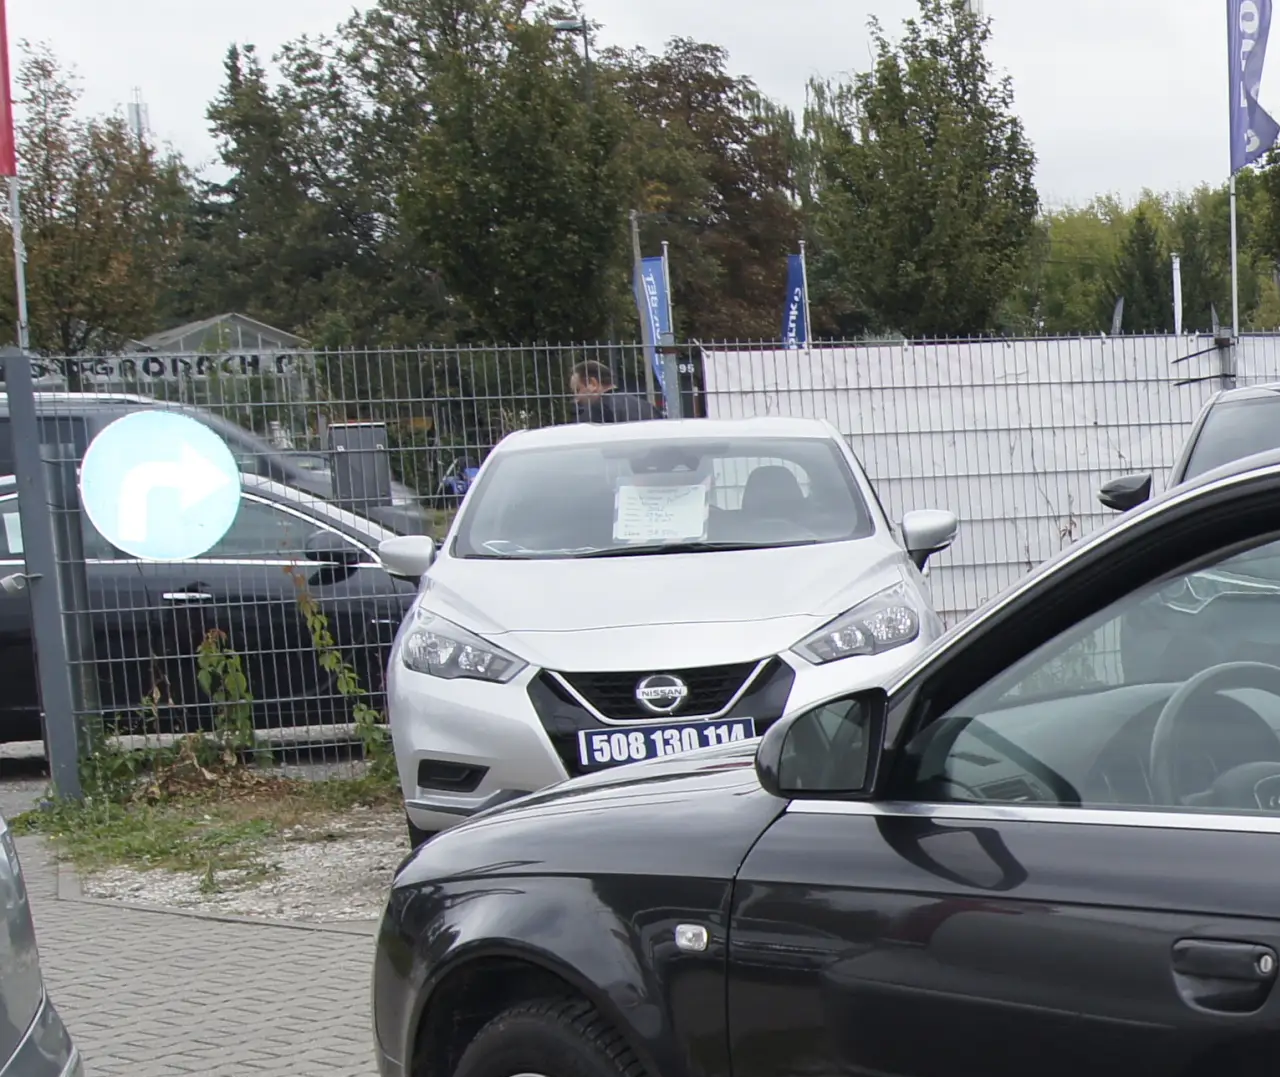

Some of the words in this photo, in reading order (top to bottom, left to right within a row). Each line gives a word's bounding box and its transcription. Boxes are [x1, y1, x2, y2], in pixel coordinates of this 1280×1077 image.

[641, 689, 682, 697] NISSAN
[592, 731, 647, 762] 508
[650, 727, 700, 758] 130
